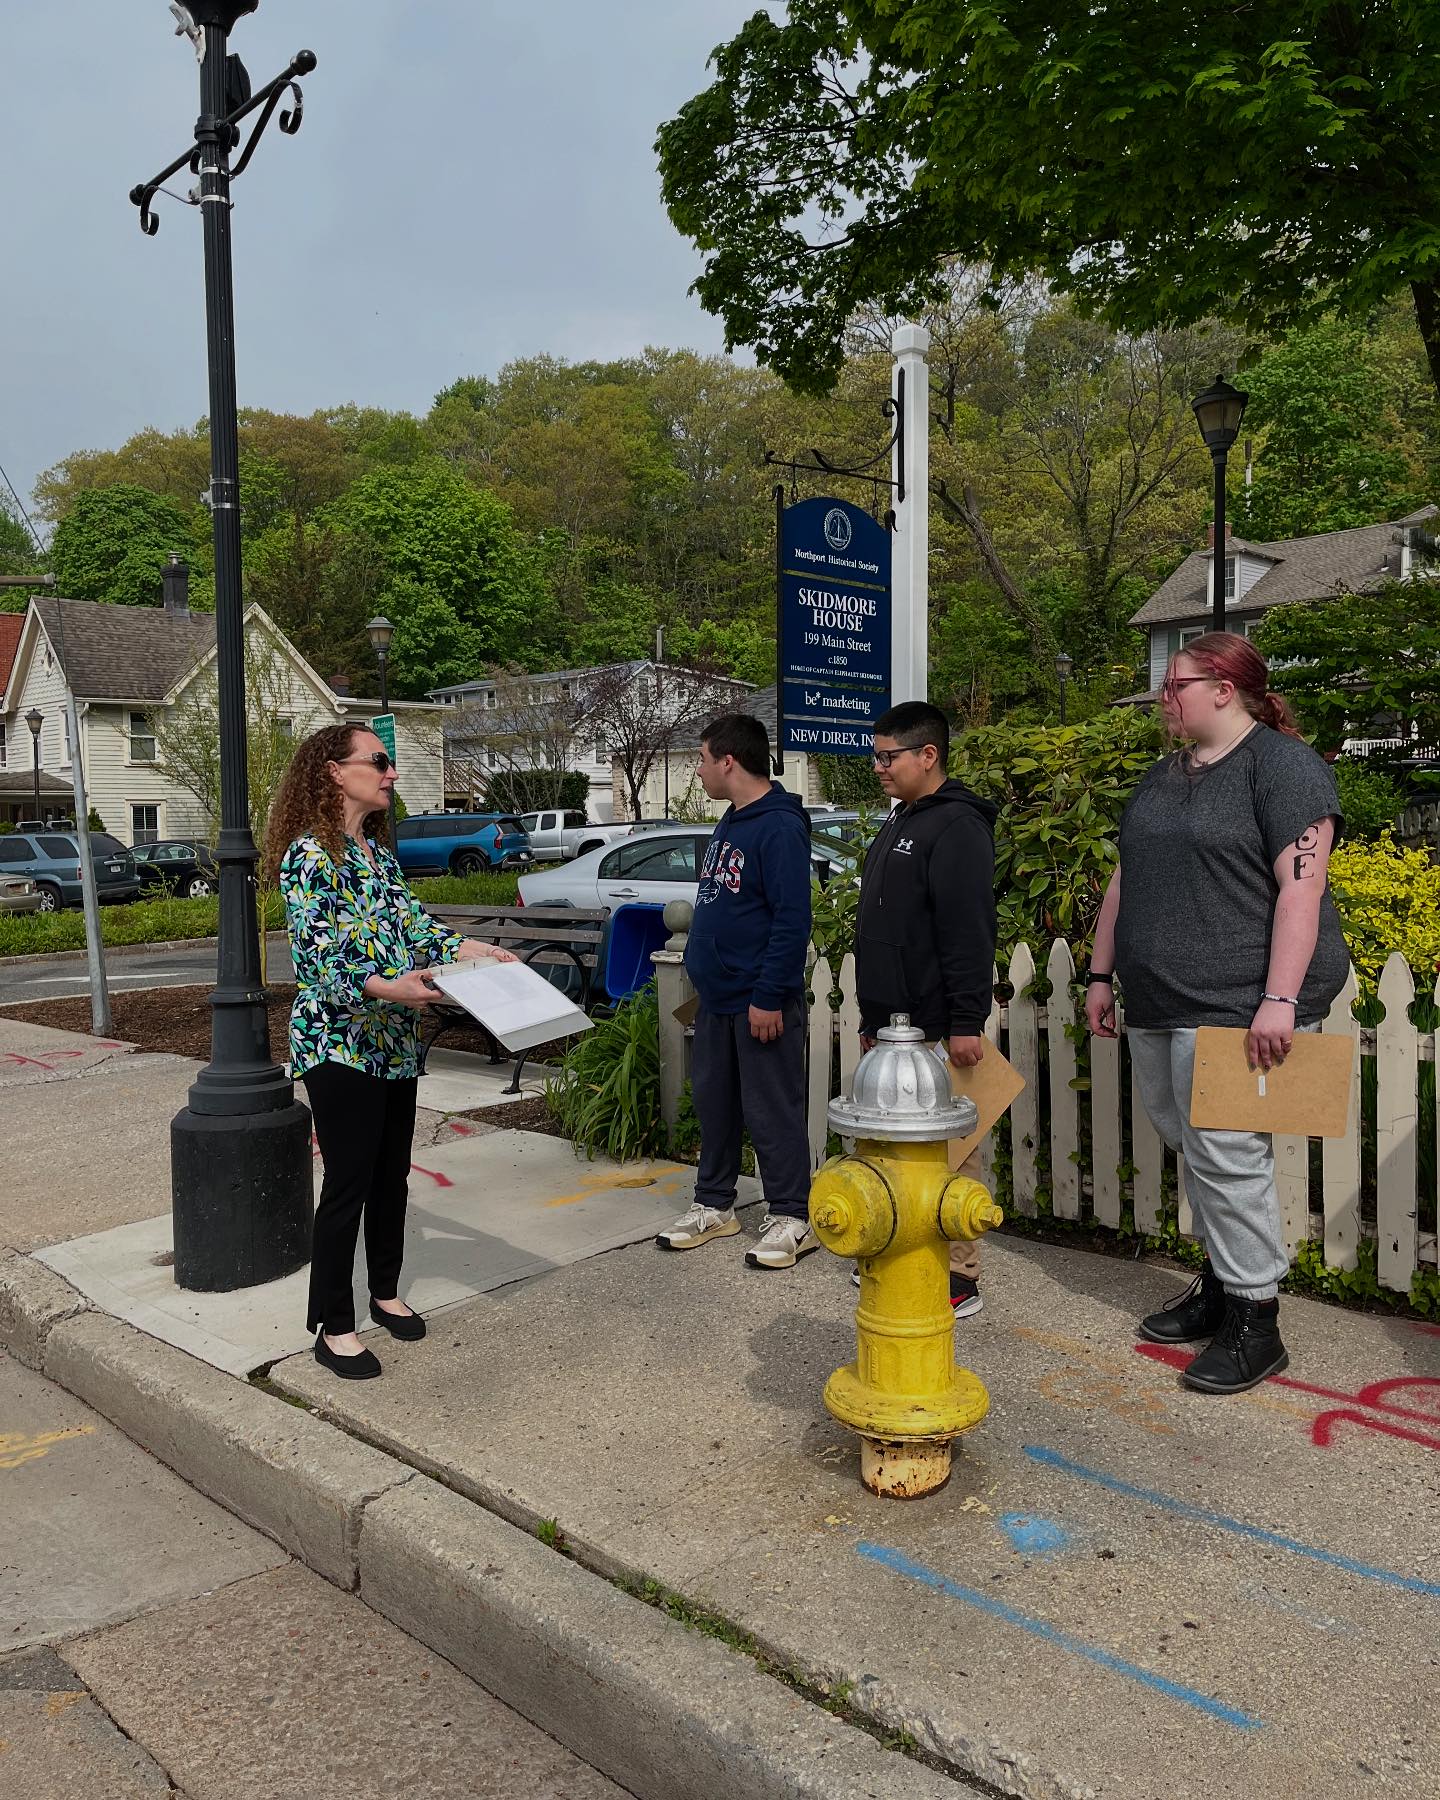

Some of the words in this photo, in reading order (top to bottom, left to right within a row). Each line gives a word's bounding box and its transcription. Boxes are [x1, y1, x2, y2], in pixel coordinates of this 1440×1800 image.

[794, 548, 826, 563] Northport
[828, 554, 857, 569] Historical
[858, 560, 880, 574] Society
[798, 587, 877, 616] SKIDMORE
[813, 608, 863, 632] HOUSE
[804, 631, 820, 645] 199
[821, 633, 845, 649] Main
[847, 637, 872, 652] Street
[812, 667, 834, 675] CAPTAIN
[822, 694, 871, 715] marketing
[790, 728, 820, 743] NEW
[821, 730, 860, 748] DIREX,
[861, 733, 876, 747] IN
